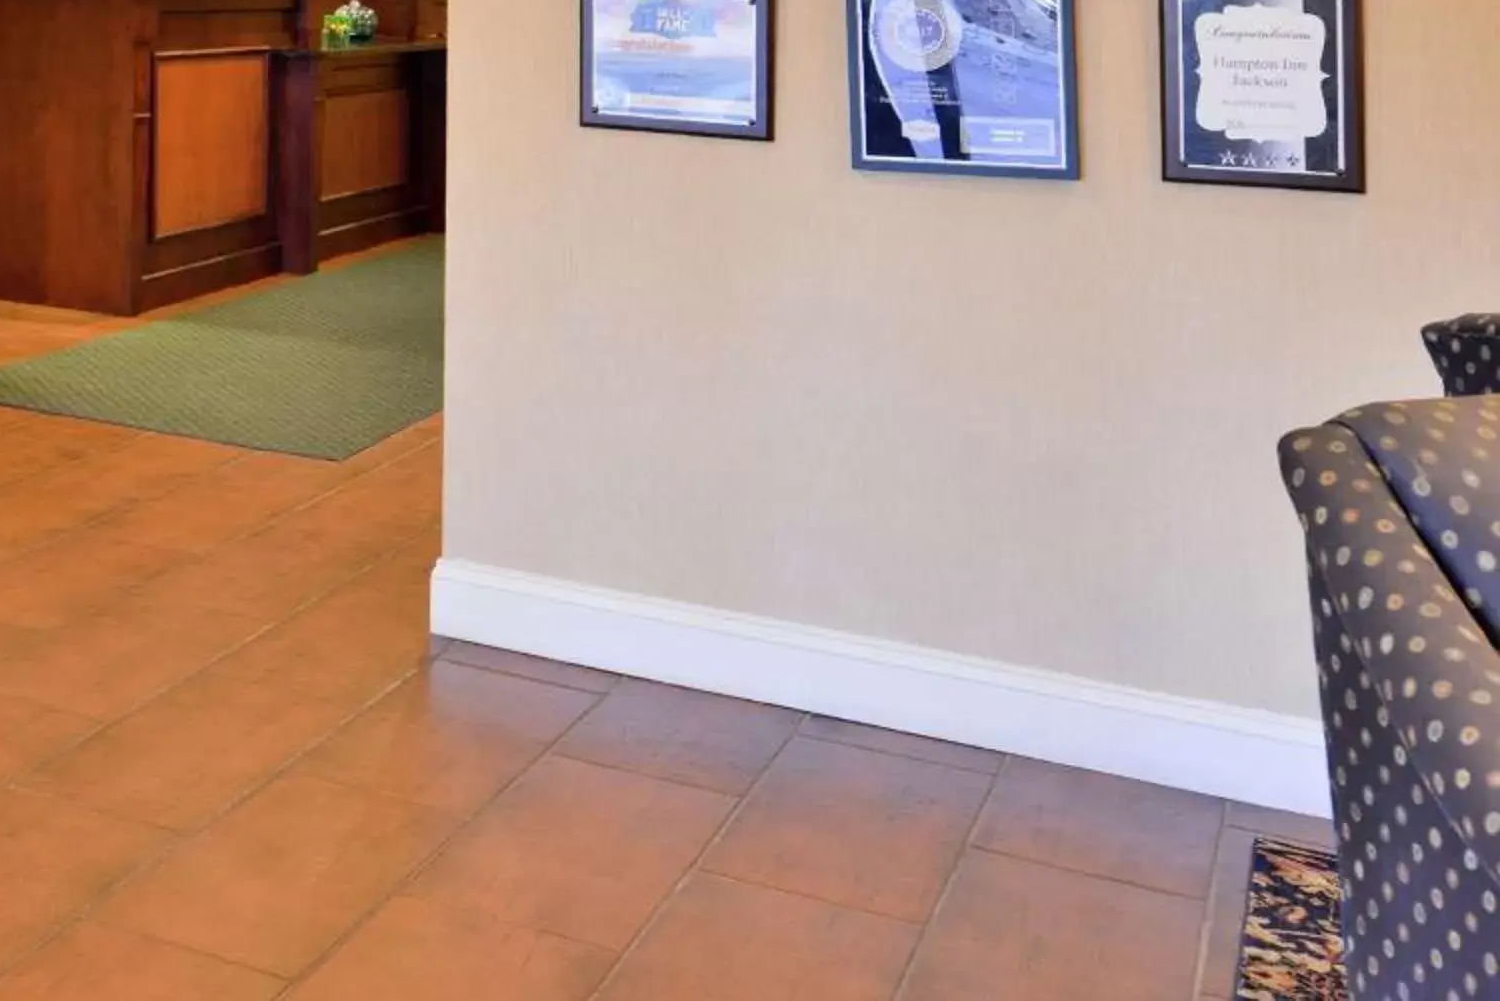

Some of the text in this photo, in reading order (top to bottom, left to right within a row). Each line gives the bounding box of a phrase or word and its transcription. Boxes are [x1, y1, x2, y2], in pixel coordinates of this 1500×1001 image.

[656, 18, 692, 32] FAME
[1212, 54, 1309, 72] Hampton Inn
[1231, 72, 1289, 89] Jackson
